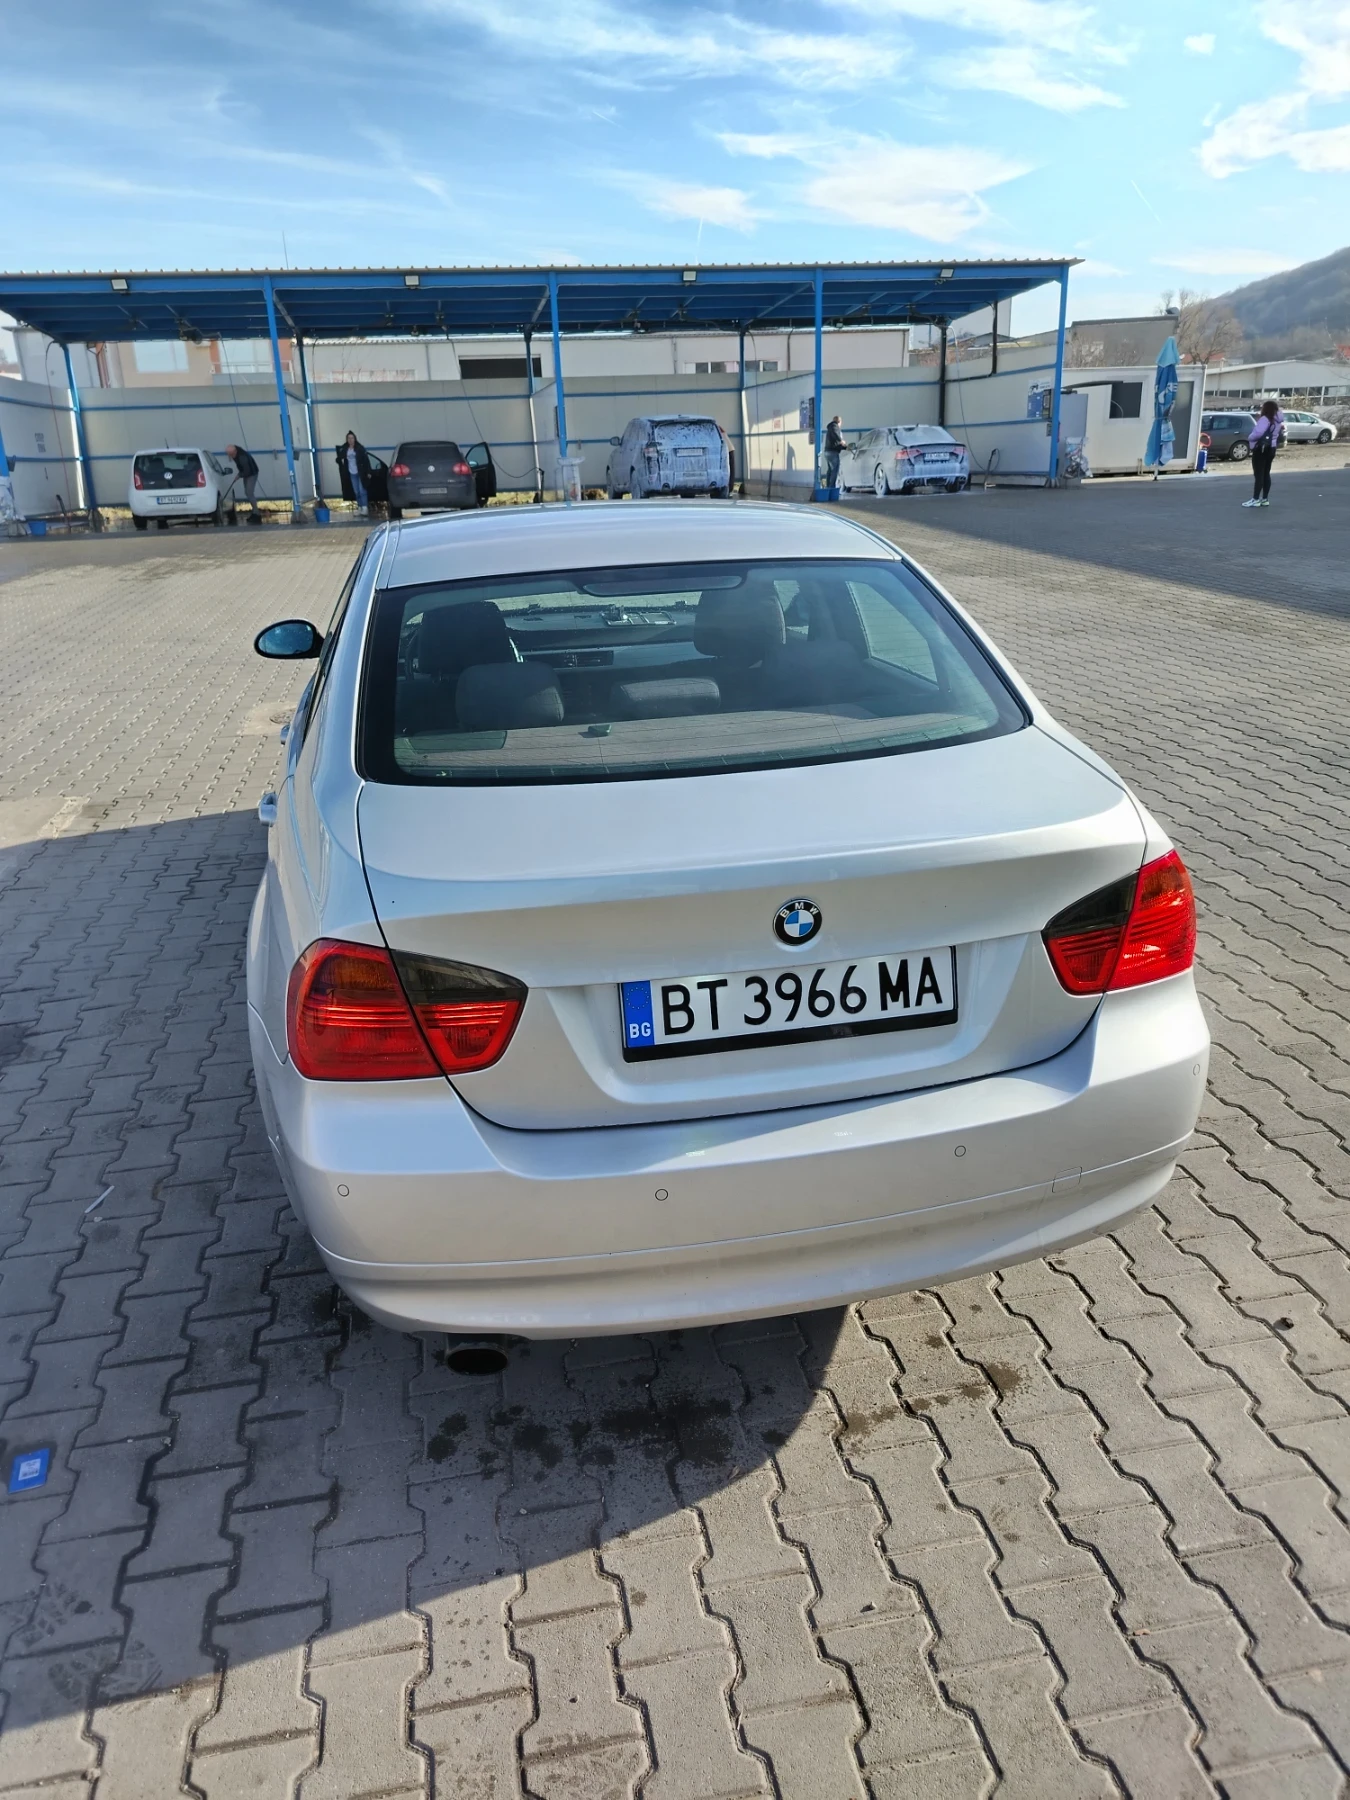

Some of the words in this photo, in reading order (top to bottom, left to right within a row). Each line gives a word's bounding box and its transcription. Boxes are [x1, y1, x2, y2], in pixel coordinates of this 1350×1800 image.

[780, 902, 819, 918] BMW
[661, 978, 728, 1035] BT
[744, 965, 867, 1026] 3966
[878, 956, 943, 1012] MA
[629, 1021, 651, 1039] BG
